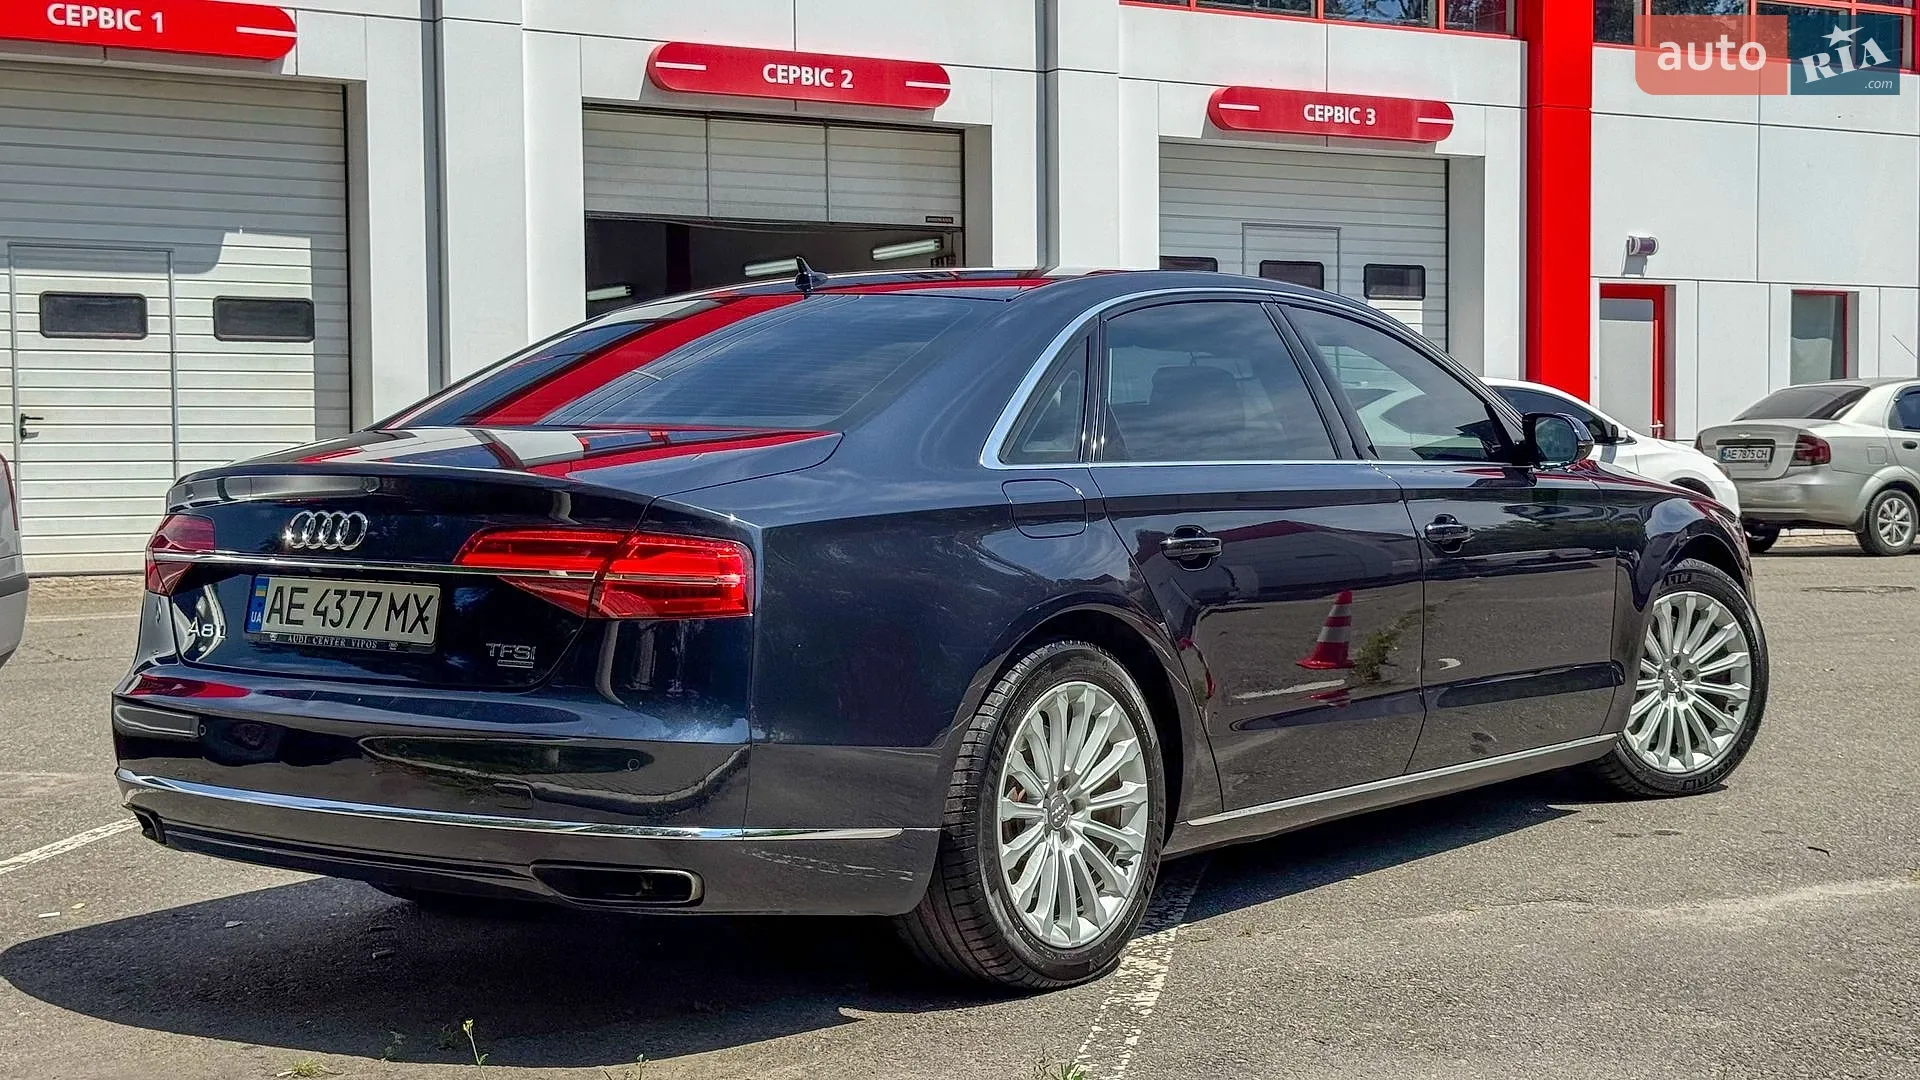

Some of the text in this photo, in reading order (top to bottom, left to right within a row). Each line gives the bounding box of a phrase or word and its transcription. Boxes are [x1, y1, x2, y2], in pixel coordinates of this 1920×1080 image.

[47, 3, 164, 34] СЕРВІС 1
[762, 63, 854, 89] СЕРВІС 2
[1303, 103, 1376, 126] СЕРВІС 3
[250, 611, 262, 623] UA
[266, 586, 434, 635] AE 4377 MX
[188, 616, 226, 639] A8L
[288, 634, 308, 645] AUDI
[312, 636, 346, 648] CENTER
[486, 643, 537, 660] TFSI
